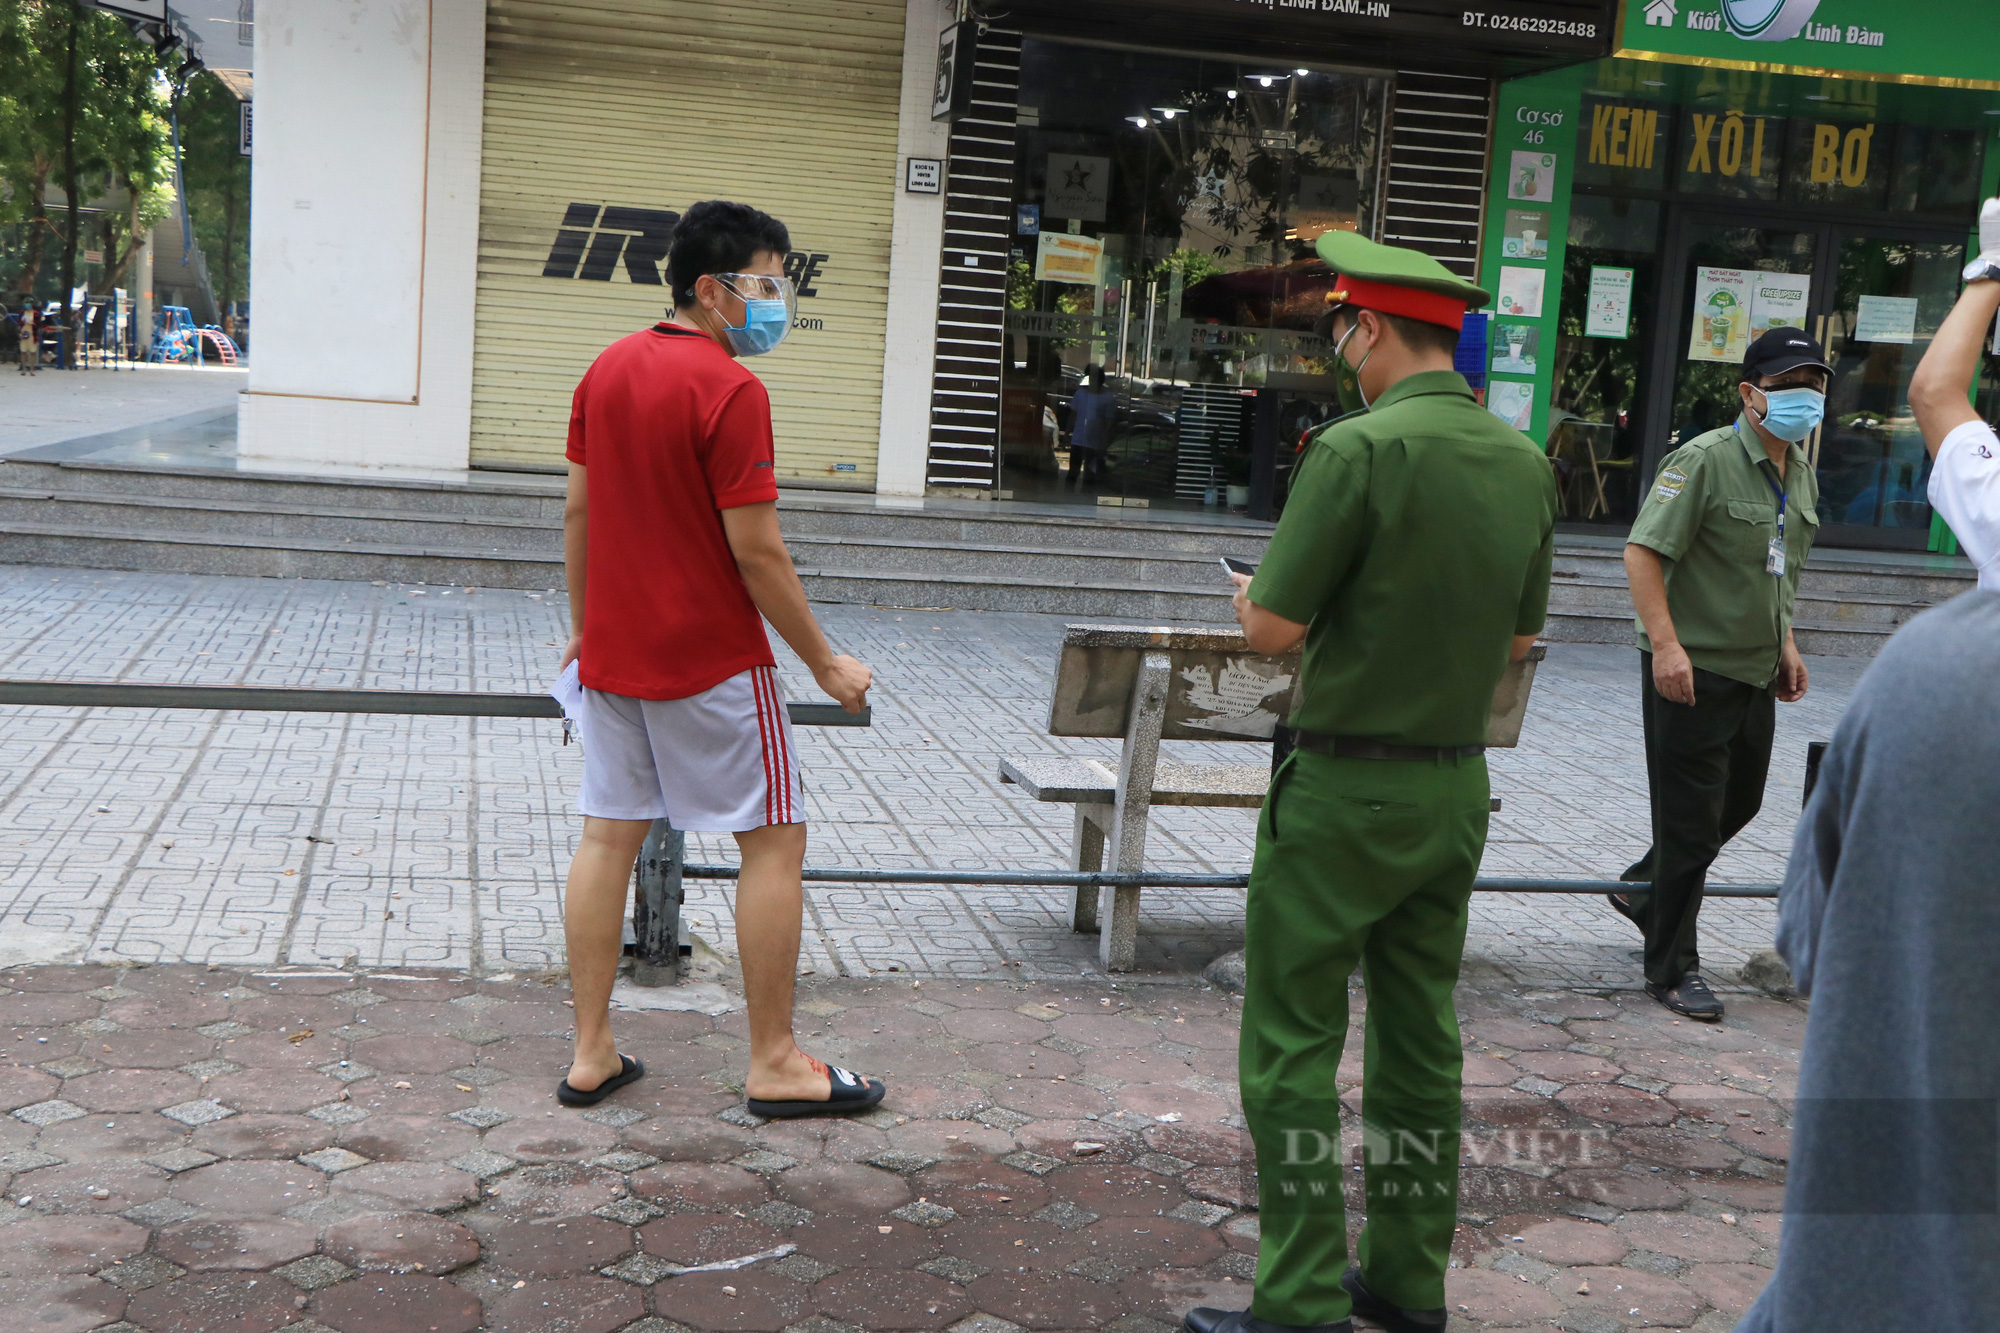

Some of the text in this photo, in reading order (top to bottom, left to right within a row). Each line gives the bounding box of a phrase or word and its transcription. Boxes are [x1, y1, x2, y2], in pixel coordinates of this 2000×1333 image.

[1490, 14, 1597, 38] 02462925488
[1686, 10, 1722, 31] Kiốt
[1804, 21, 1841, 42] Linh
[1845, 25, 1884, 47] Đàm
[1516, 106, 1563, 126] Cơ sở
[1523, 130, 1544, 144] 46
[1588, 104, 1875, 187] KEM XÔI BƠ
[1761, 288, 1802, 300] FREE UPSIZE
